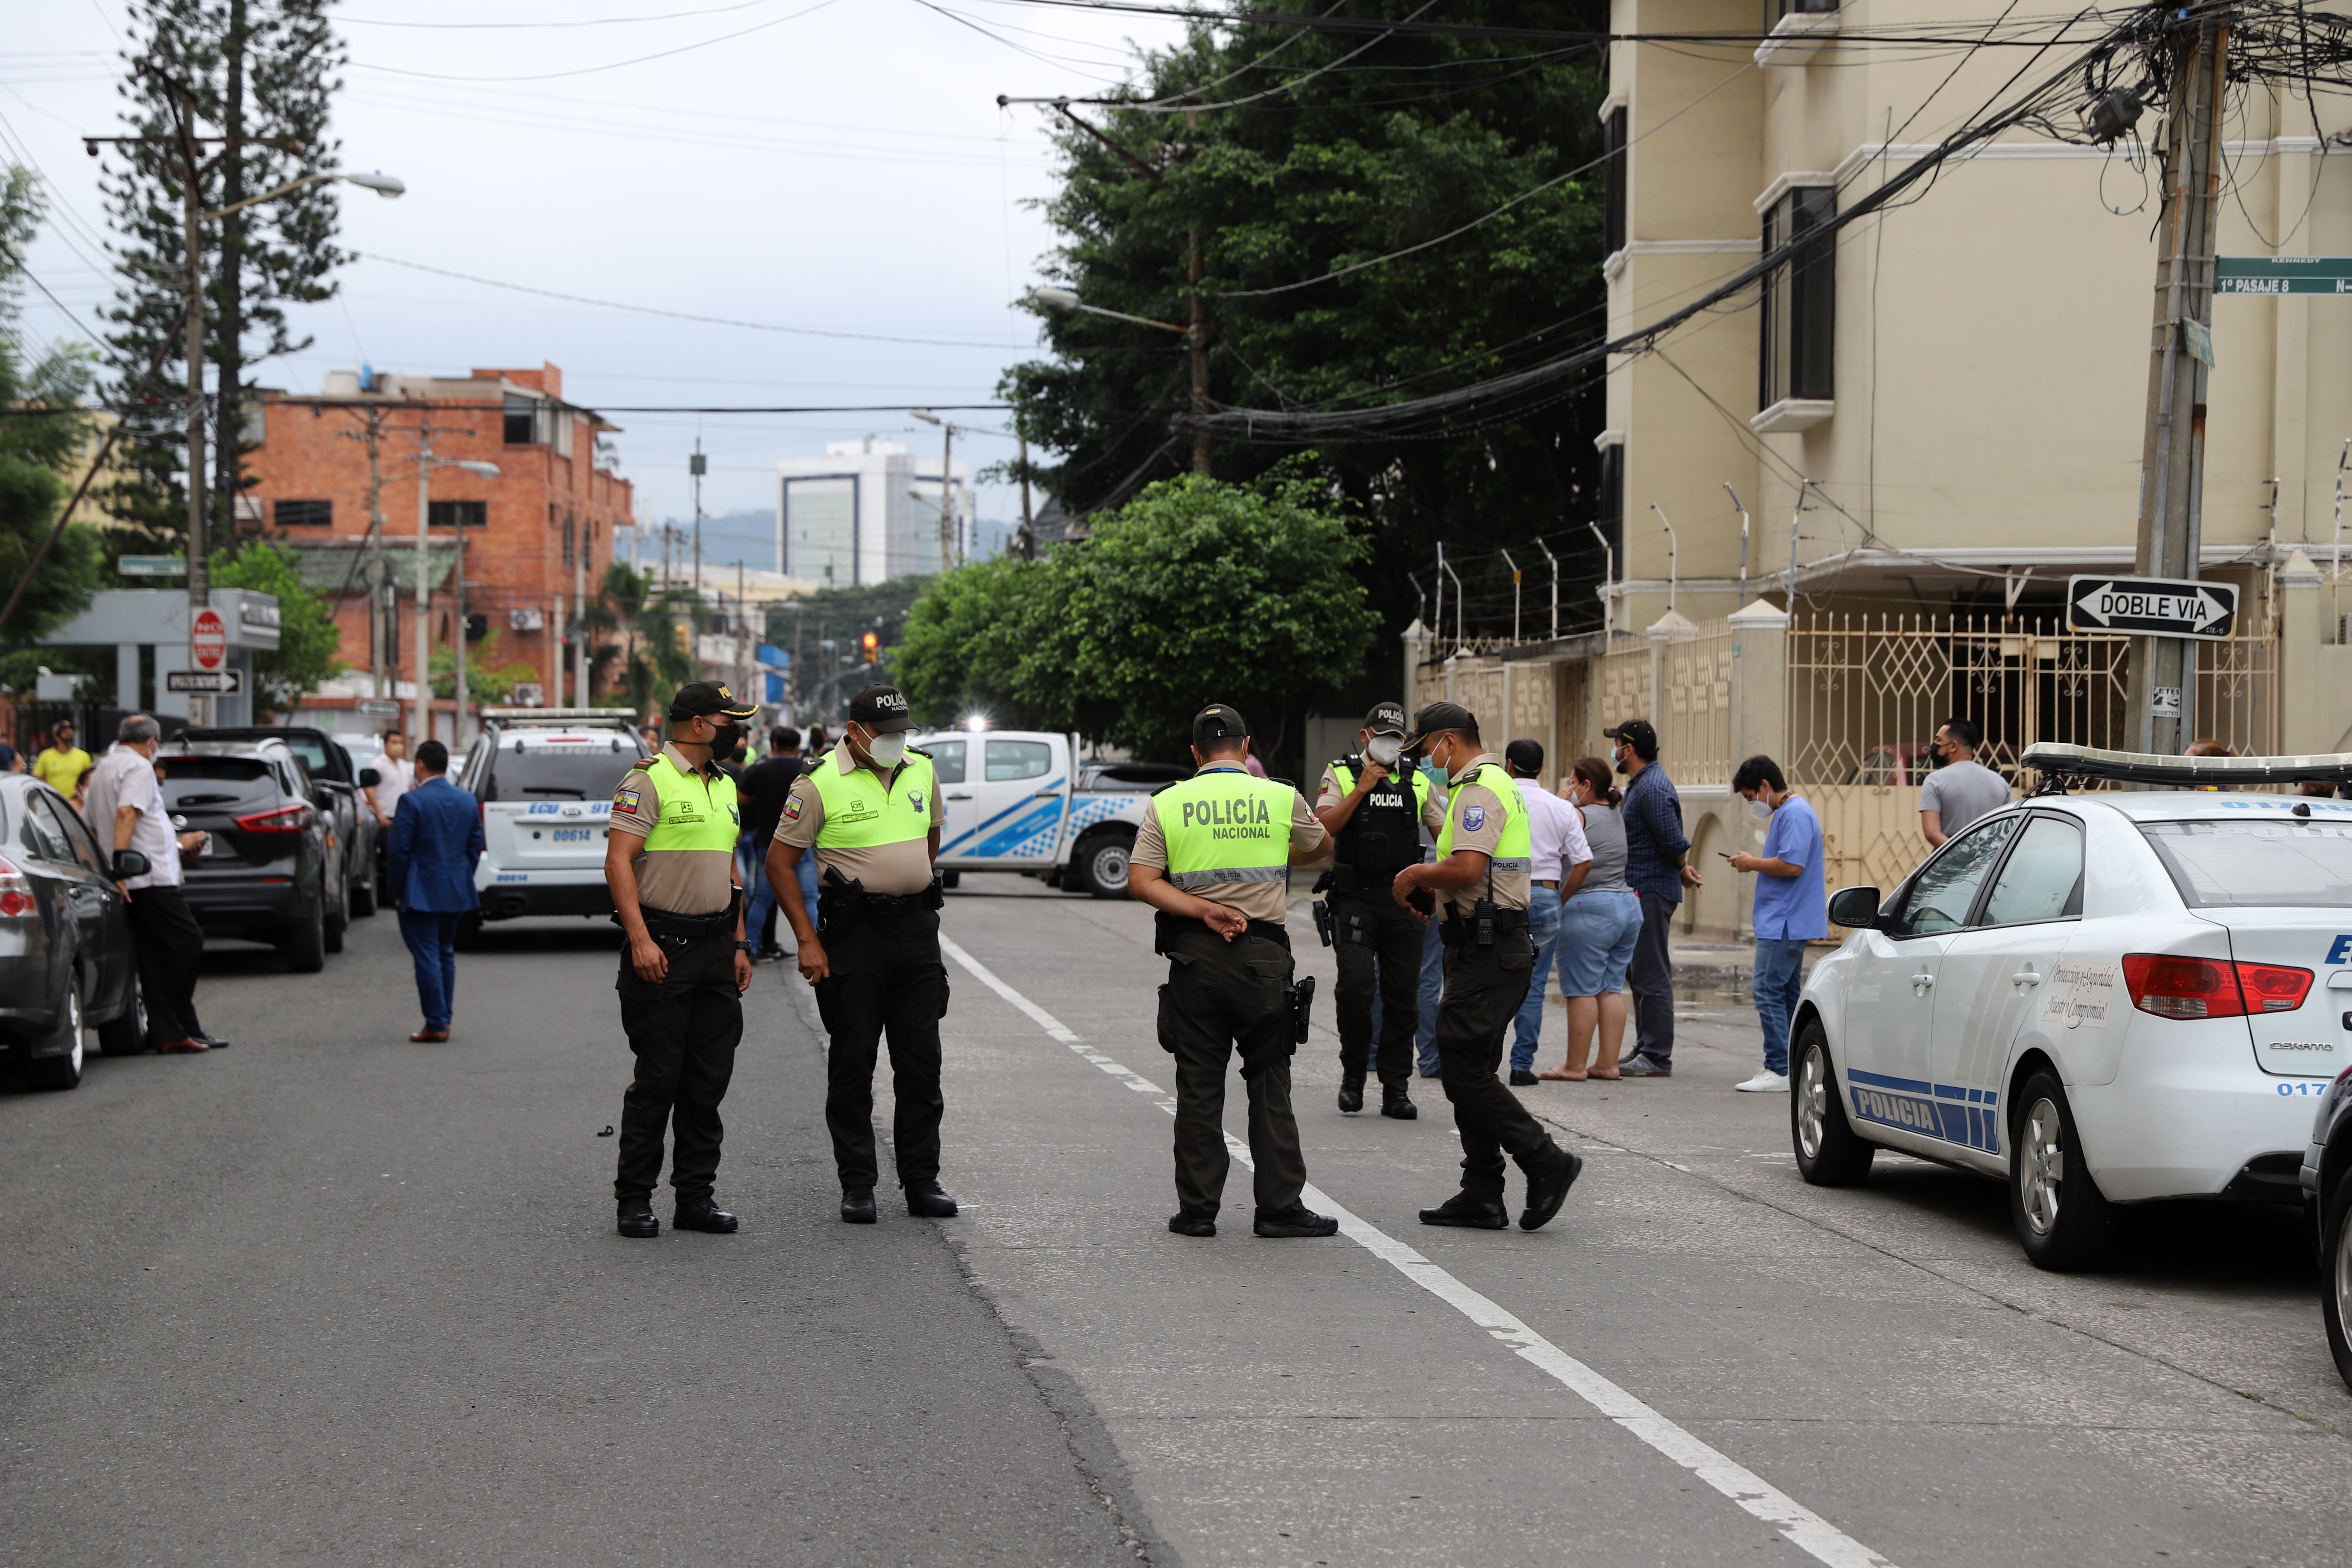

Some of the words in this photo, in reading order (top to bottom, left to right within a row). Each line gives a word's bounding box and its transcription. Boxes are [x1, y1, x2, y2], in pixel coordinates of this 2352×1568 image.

[2236, 279, 2279, 292] PASAJE
[2282, 279, 2289, 292] 8
[2101, 595, 2170, 617] DOBLE
[2177, 598, 2207, 620] VIA
[198, 622, 222, 632] NO
[1370, 791, 1403, 807] POLICIA
[528, 803, 560, 814] ECU
[1183, 794, 1270, 828] POLICÍA
[553, 830, 591, 841] 00614
[1213, 827, 1270, 840] NACIONAL
[2053, 965, 2080, 984] Protección
[2270, 1042, 2333, 1051] CERATO
[1857, 1090, 1935, 1131] POLICIA
